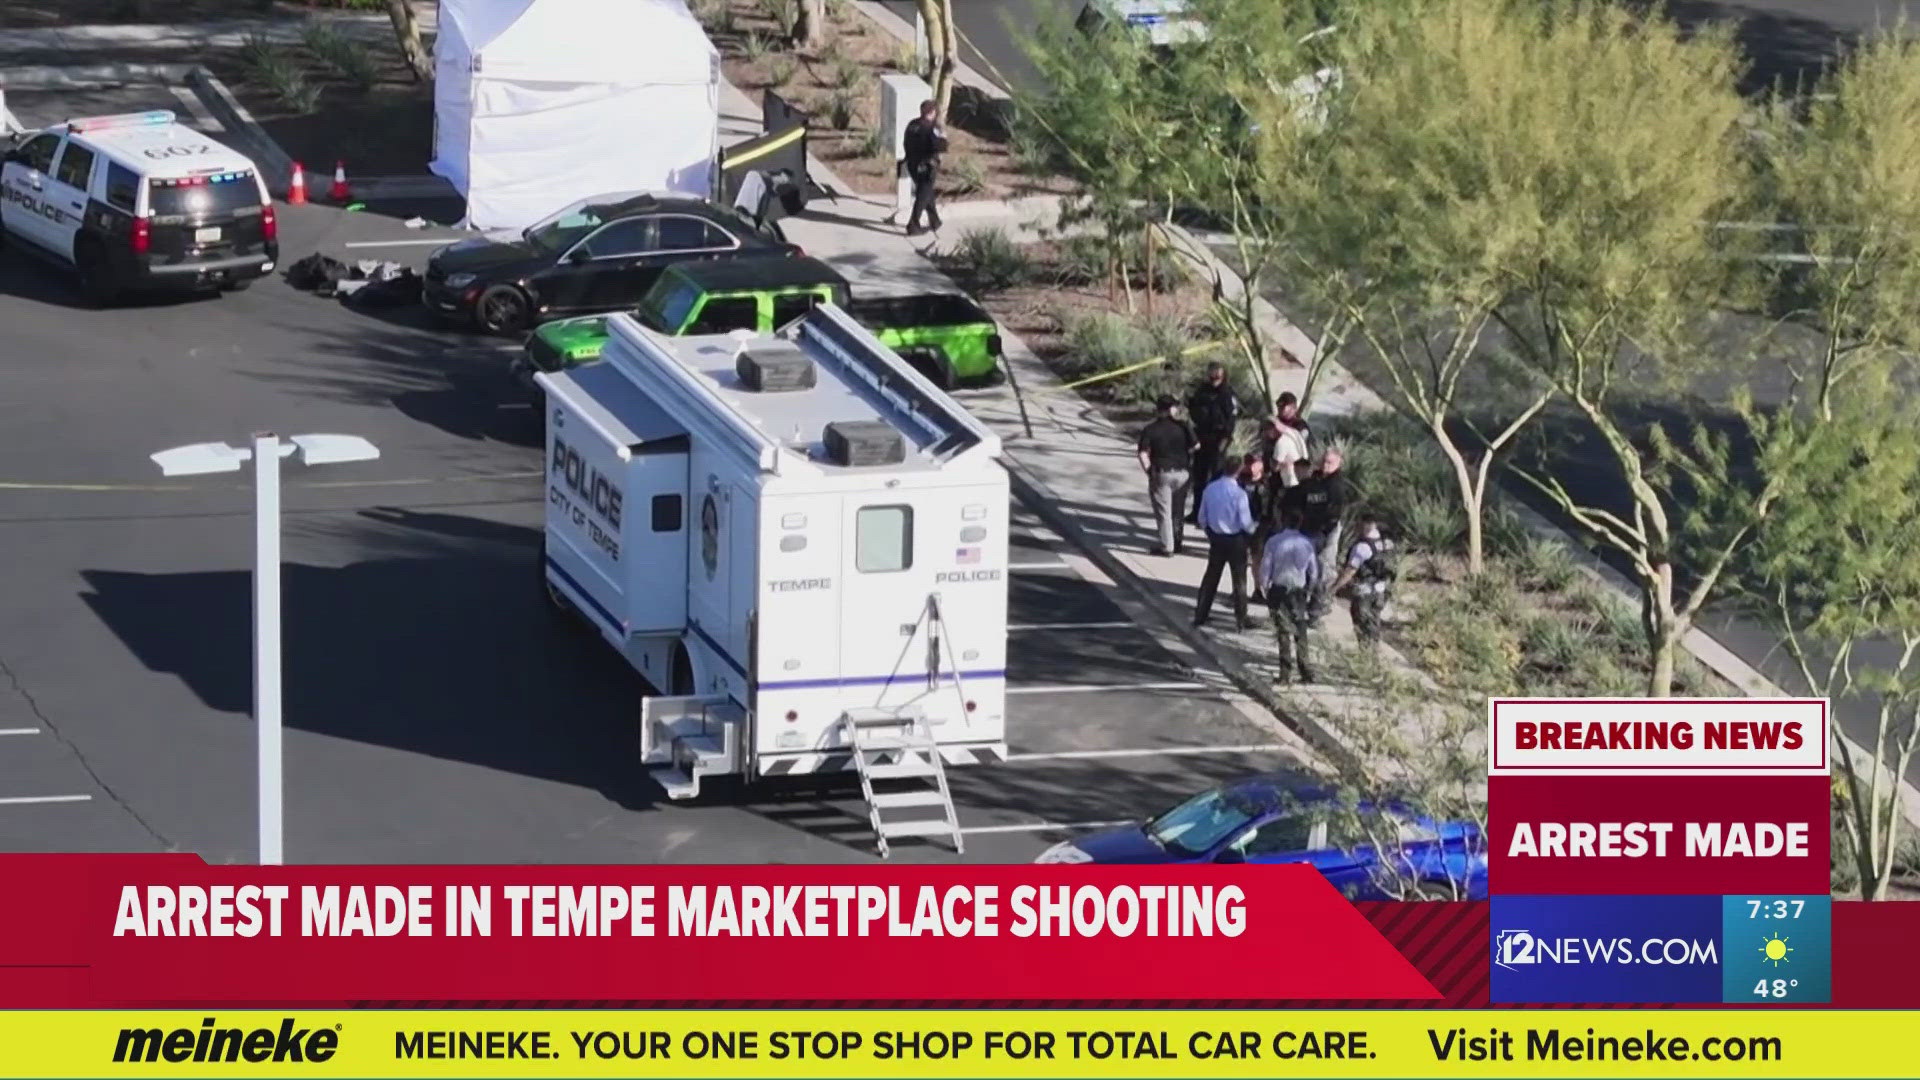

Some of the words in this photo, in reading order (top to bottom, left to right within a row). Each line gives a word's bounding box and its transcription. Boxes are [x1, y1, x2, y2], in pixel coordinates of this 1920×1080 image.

[14, 189, 64, 223] POLICE
[551, 433, 623, 534] POLICE
[550, 485, 571, 514] CITY
[572, 505, 587, 526] OF
[588, 518, 620, 561] TEMPE
[767, 577, 832, 592] TEMPE
[935, 570, 1001, 584] POLICE
